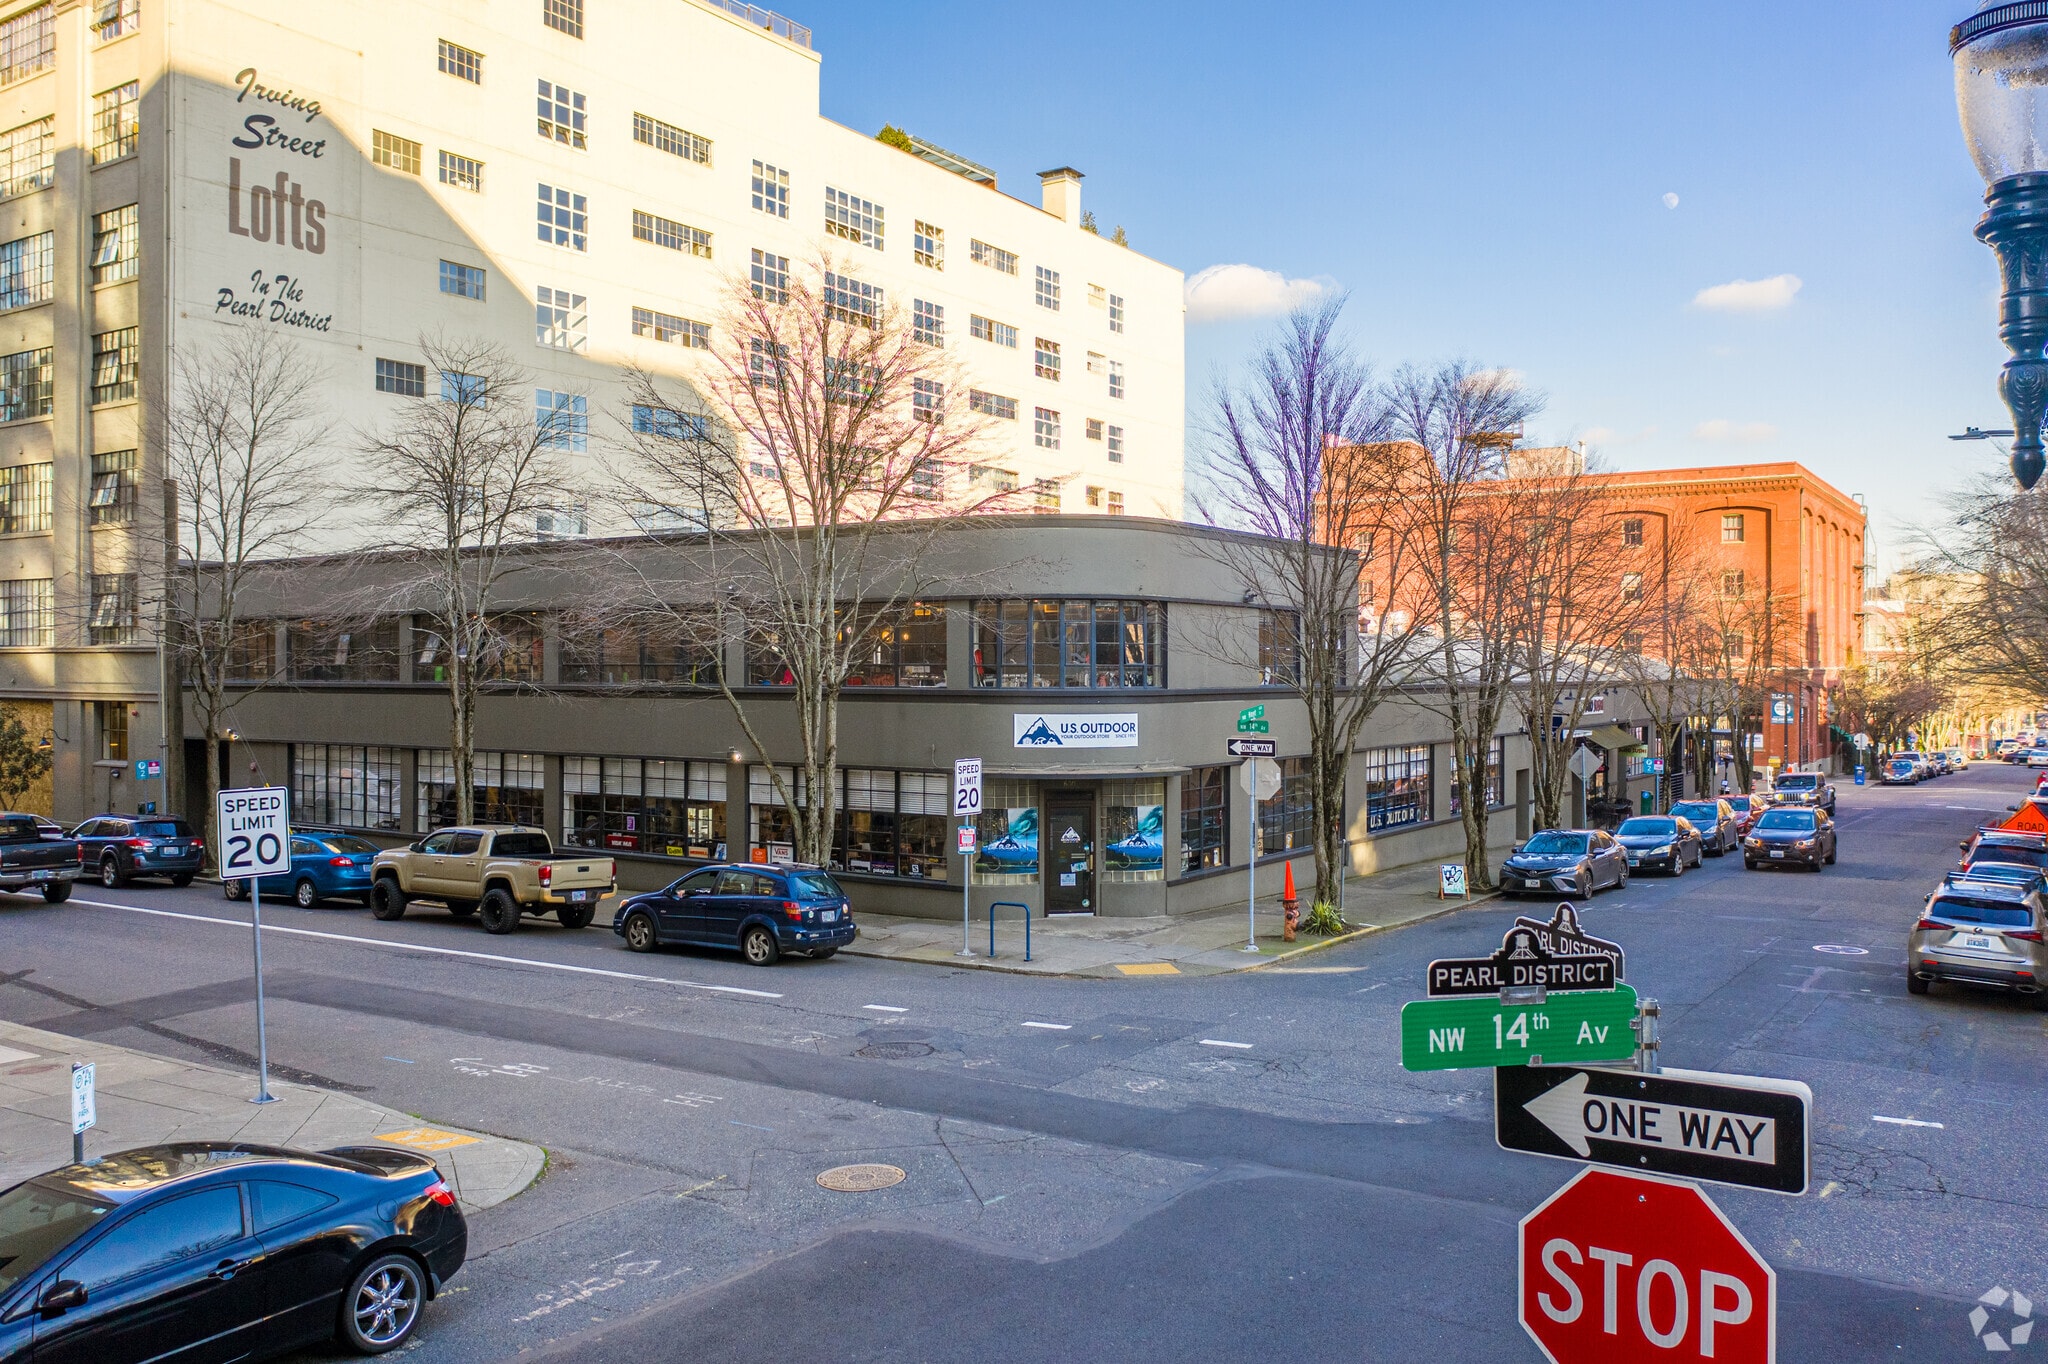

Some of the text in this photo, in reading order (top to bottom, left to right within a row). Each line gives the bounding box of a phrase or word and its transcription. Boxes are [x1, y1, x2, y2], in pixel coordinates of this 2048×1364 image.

[235, 67, 322, 123] Irving
[232, 114, 326, 158] Street
[228, 156, 326, 255] Lofts
[251, 269, 304, 302] In The
[215, 287, 333, 332] Pearl District
[1060, 722, 1137, 734] U.S. OUTDOOR
[1241, 744, 1255, 752] ONE
[958, 764, 979, 775] SPEED
[960, 776, 977, 786] LIMIT
[225, 797, 281, 813] SPEED
[957, 787, 979, 809] 20
[231, 815, 276, 831] LIMIT
[2016, 821, 2045, 831] ROAD
[227, 833, 281, 868] 20
[611, 839, 633, 848] YAKMA
[774, 848, 789, 856] VANS
[1435, 962, 1609, 988] PEARL DISTRICT
[1429, 1028, 1466, 1053] NW
[1492, 1012, 1550, 1050] 14th
[1582, 1099, 1767, 1157] ONE WAY
[1537, 1238, 1753, 1359] STOP
